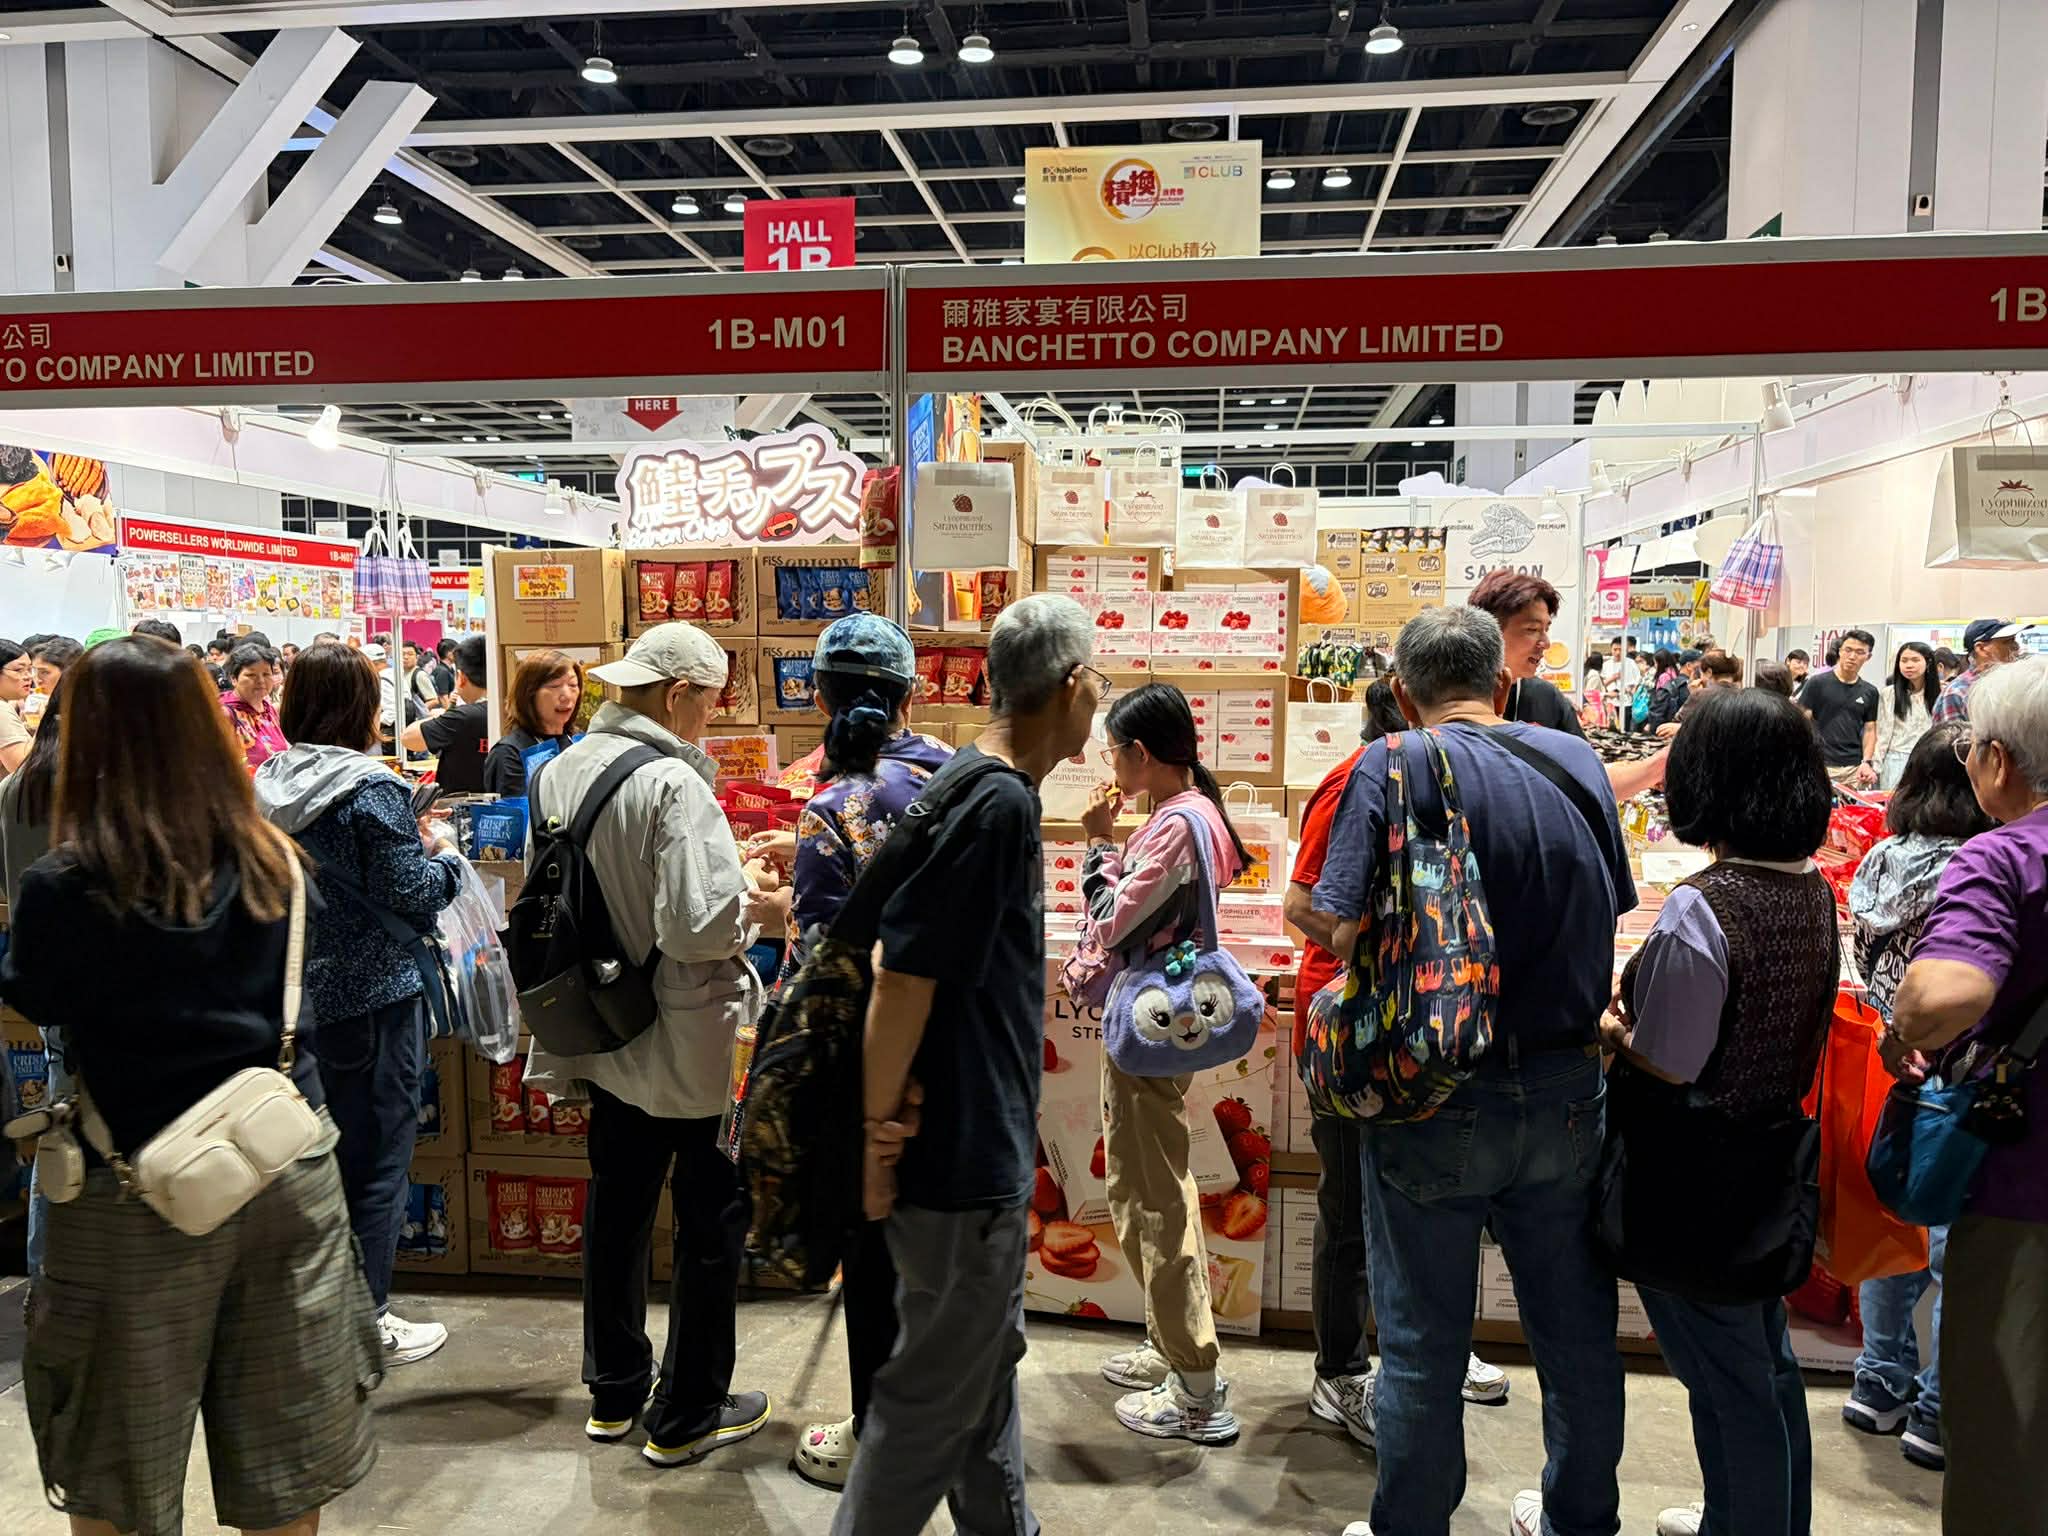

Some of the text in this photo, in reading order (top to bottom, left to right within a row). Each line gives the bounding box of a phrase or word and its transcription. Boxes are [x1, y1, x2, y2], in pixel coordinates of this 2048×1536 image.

[1198, 165, 1243, 178] CLUB
[768, 220, 832, 244] HALL
[768, 246, 832, 272] 1B
[943, 294, 1188, 327] 爾雅家宴有限公司
[2, 324, 50, 350] 公司
[708, 315, 846, 350] 1B-M01
[943, 324, 1504, 363] BANCHETTO COMPANY LIMITED
[36, 353, 185, 381] COMPANY
[195, 351, 315, 378] LIMITED
[635, 399, 670, 411] HERE
[129, 527, 298, 557] POWERSELLERS WORLDWIDE LIMITED
[479, 817, 512, 832] CRISPY
[535, 1186, 575, 1200] CRISPY
